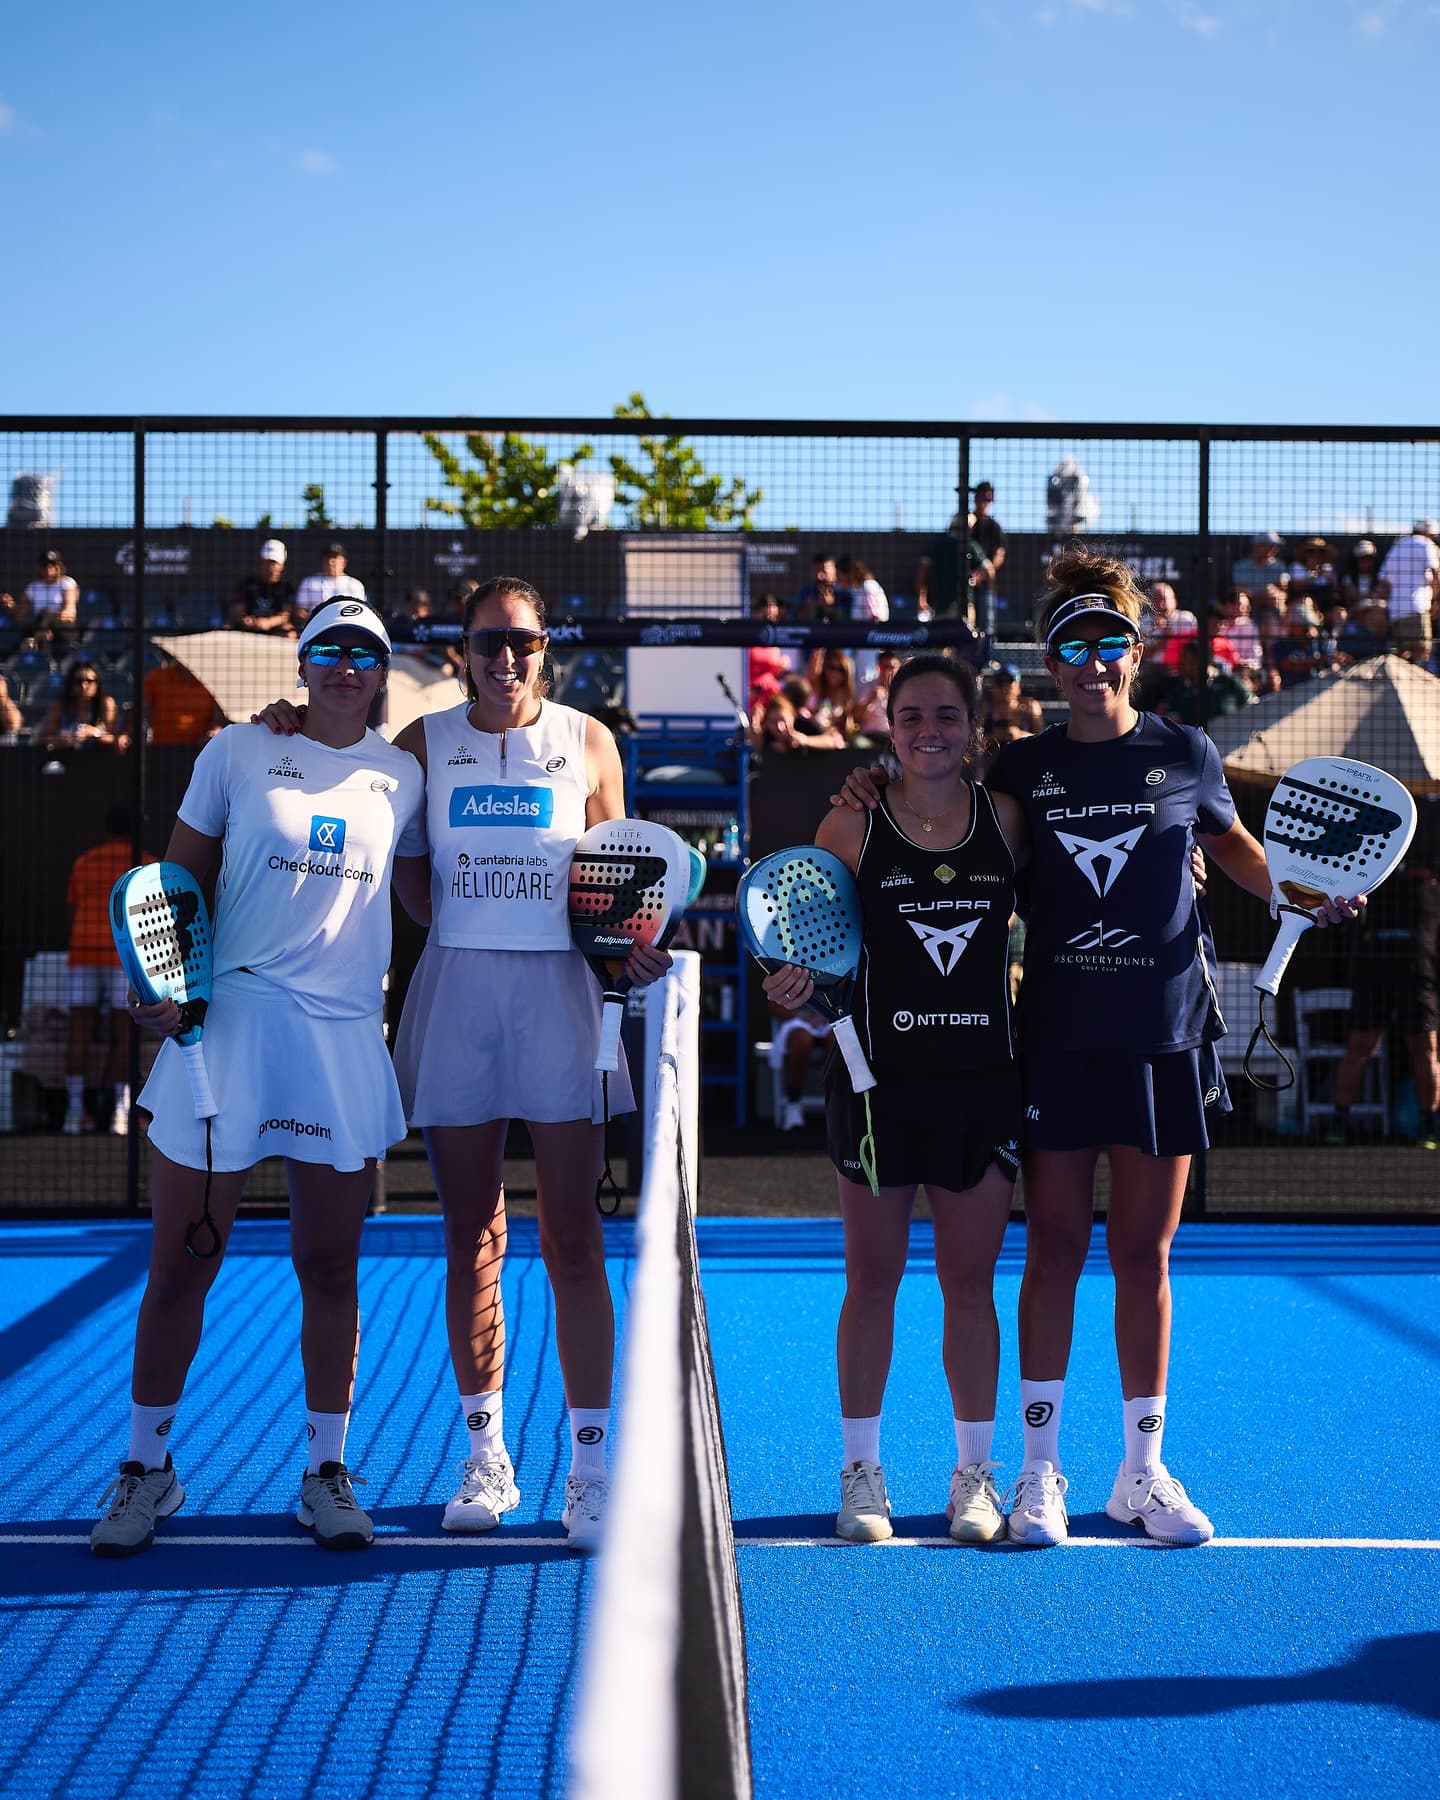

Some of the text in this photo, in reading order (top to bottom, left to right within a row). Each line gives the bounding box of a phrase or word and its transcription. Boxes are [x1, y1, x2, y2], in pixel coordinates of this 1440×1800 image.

[447, 757, 479, 766] PADEL
[267, 768, 305, 780] PADEL
[1032, 786, 1067, 799] PADEL
[461, 793, 541, 817] Adeslas
[1046, 803, 1156, 822] CUPRA
[610, 831, 643, 839] ELITE
[474, 855, 549, 867] cantabria labs
[267, 855, 375, 884] Checkout.com
[451, 871, 555, 901] HELIOCARE
[881, 877, 915, 889] PADEL
[898, 900, 991, 913] CUPRA
[593, 935, 635, 946] Bullpadel
[1115, 956, 1156, 967] DUNES
[917, 1013, 948, 1026] NTT
[1026, 1104, 1041, 1121] fit
[258, 1118, 334, 1142] proofpoint
